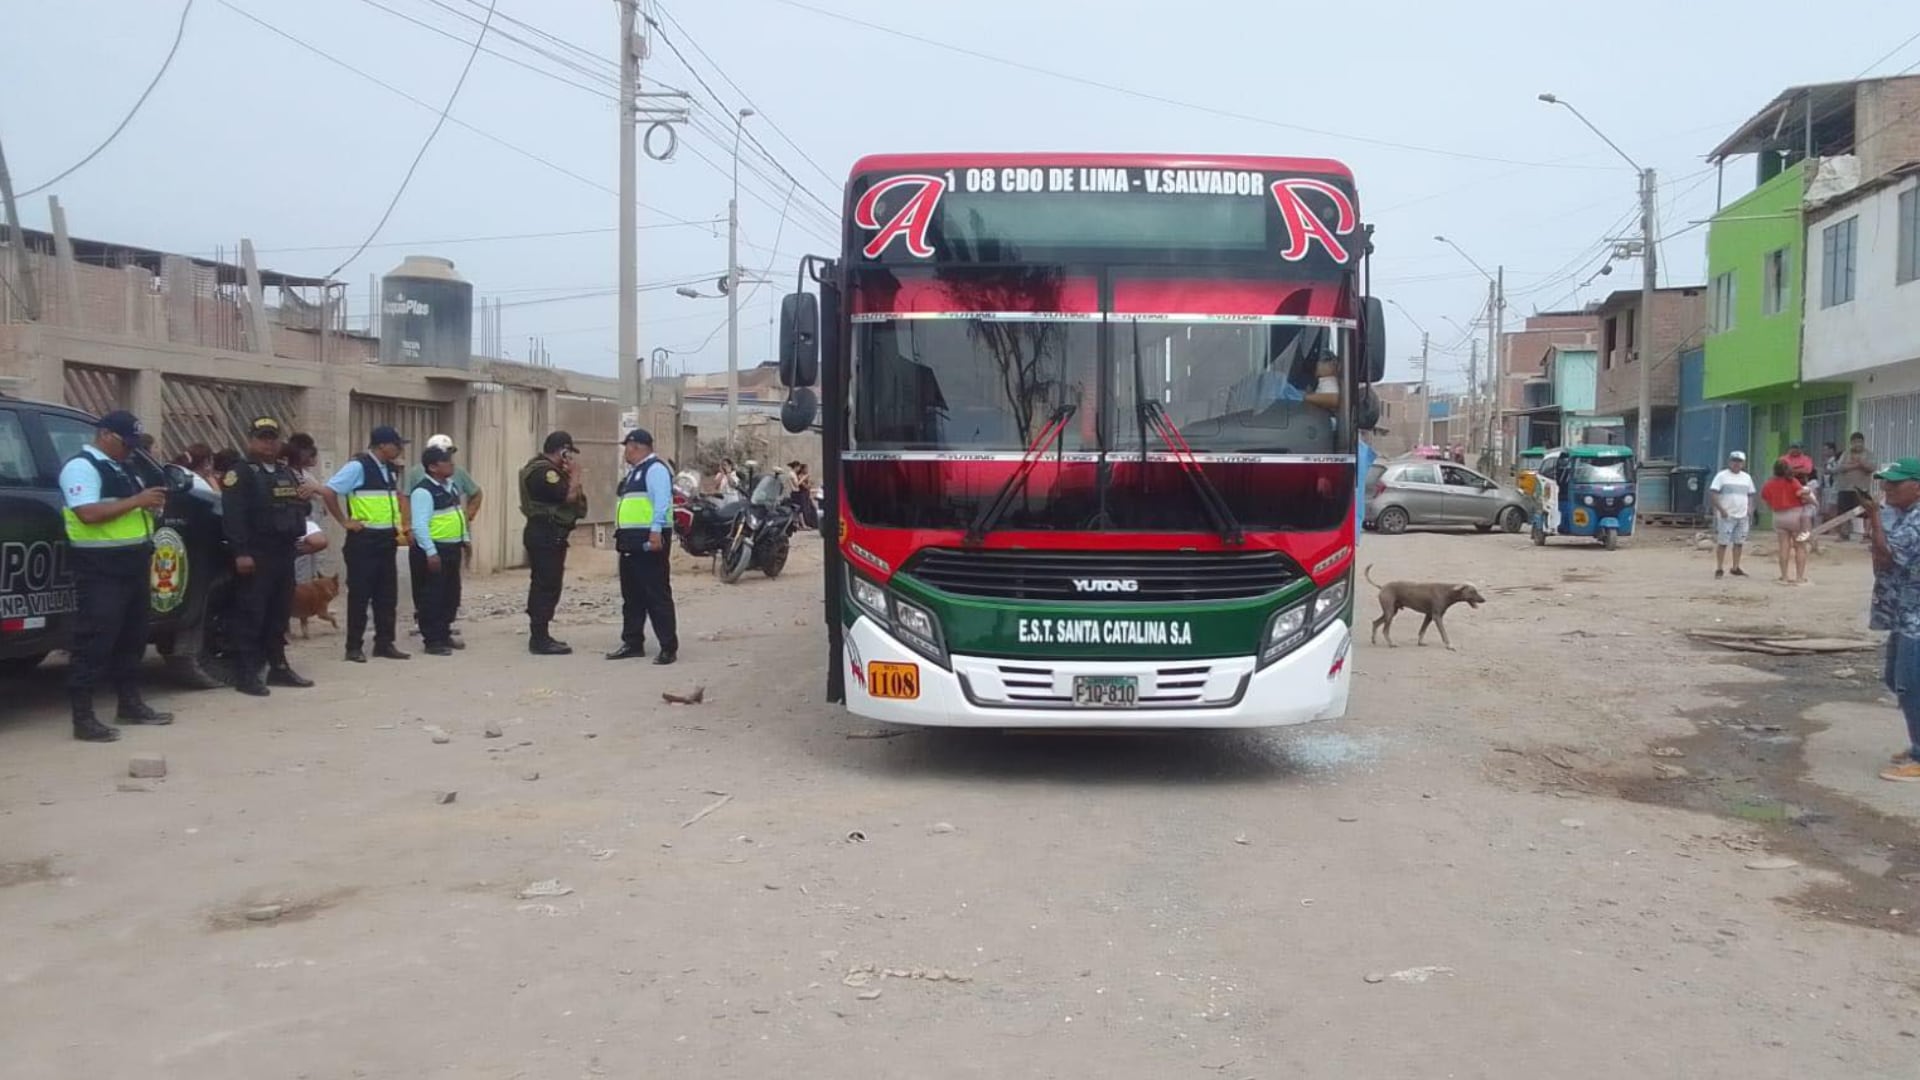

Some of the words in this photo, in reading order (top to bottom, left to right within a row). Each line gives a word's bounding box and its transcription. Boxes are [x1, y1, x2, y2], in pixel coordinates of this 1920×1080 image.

[944, 169, 955, 192] 1
[966, 168, 996, 192] 08
[1001, 168, 1044, 192] CDO
[1049, 168, 1075, 192] DE
[1080, 168, 1130, 192] LIMA
[1144, 169, 1264, 196] V.SALVADOR
[0, 541, 76, 592] POL
[1073, 579, 1138, 592] YUTONG
[1019, 619, 1053, 642] E.S.T.
[1057, 620, 1100, 643] SANTA
[1103, 620, 1167, 644] CATALINA
[1170, 621, 1192, 644] S.A
[870, 671, 915, 697] 1108
